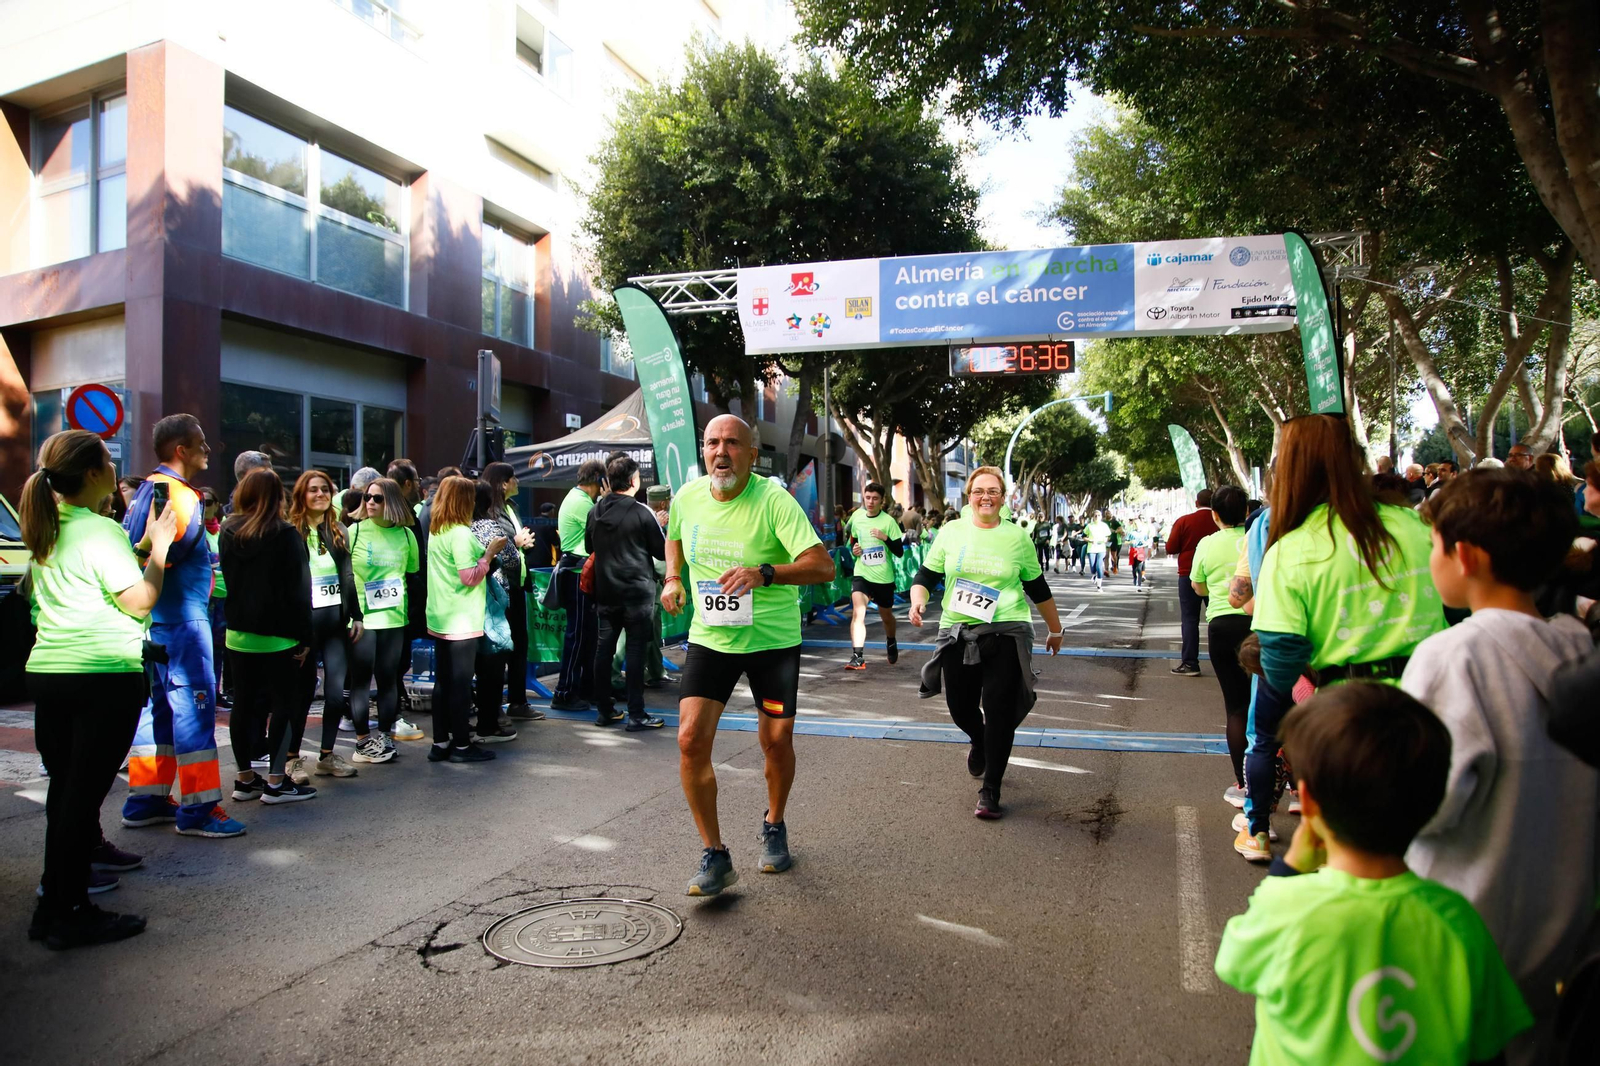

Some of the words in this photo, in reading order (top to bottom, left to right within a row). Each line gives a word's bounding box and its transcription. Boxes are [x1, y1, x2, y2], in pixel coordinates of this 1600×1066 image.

[1165, 252, 1214, 266] cajamar
[895, 262, 984, 285] Almería
[991, 263, 1020, 279] en
[1029, 254, 1119, 277] marcha
[1212, 278, 1269, 291] Fundación
[848, 298, 869, 308] SOLAN
[895, 289, 970, 310] contra
[975, 285, 999, 305] el
[1004, 284, 1088, 304] cáncer
[1241, 295, 1262, 305] Ejido
[1263, 294, 1288, 303] Motor
[1077, 310, 1105, 318] asociación
[1170, 305, 1195, 313] Toyota
[1170, 312, 1198, 320] Alborán
[698, 536, 709, 544] En
[710, 537, 745, 549] marcha
[697, 546, 731, 557] contra
[733, 549, 744, 559] el
[863, 551, 884, 561] 1146
[697, 556, 745, 568] cáncer
[320, 583, 341, 596] 502
[374, 587, 398, 600] 493
[704, 595, 740, 611] 965
[956, 590, 994, 610] 1127
